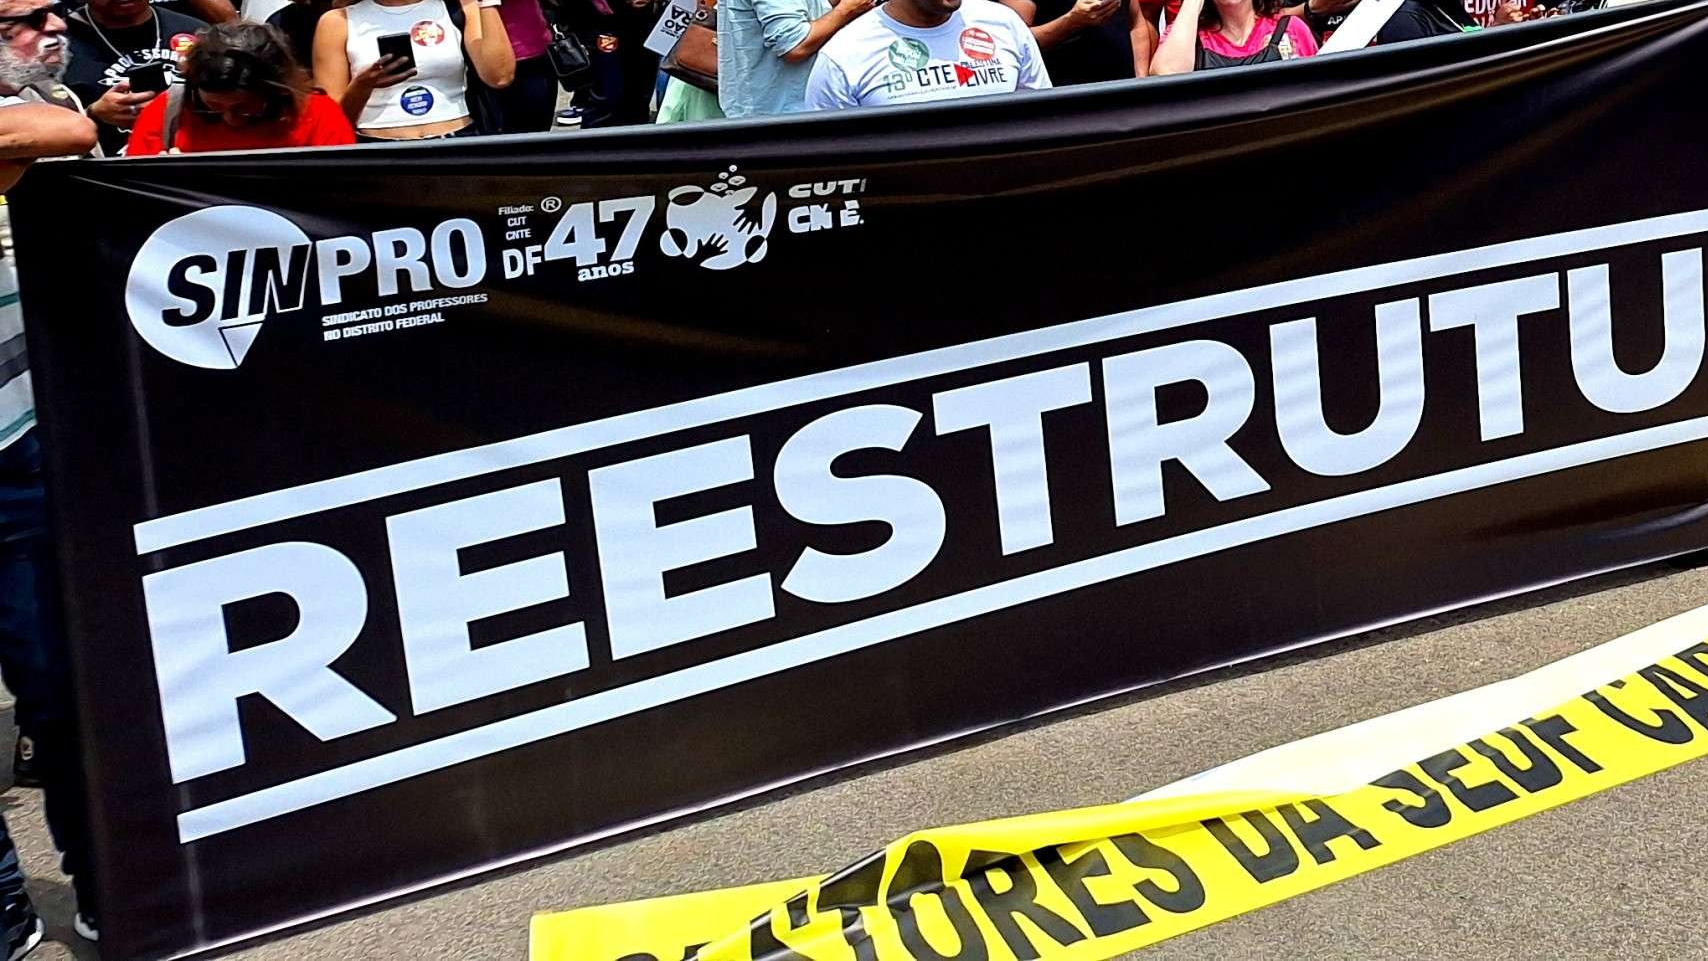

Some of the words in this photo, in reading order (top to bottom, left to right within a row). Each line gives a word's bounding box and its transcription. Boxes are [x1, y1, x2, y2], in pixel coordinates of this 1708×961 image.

[916, 64, 956, 87] CTE
[965, 67, 1008, 87] LIVRE
[507, 215, 527, 227] CUT
[502, 244, 543, 280] DF
[543, 195, 656, 267] 47
[505, 228, 532, 241] CNTE
[161, 217, 488, 329] SINPRO
[577, 260, 635, 282] anos
[321, 307, 382, 327] SINDICATO
[384, 303, 408, 317] DOS
[409, 293, 488, 312] PROFESSORES
[323, 330, 341, 342] NO
[342, 319, 393, 338] DISTRITO
[395, 312, 446, 330] FEDERAL
